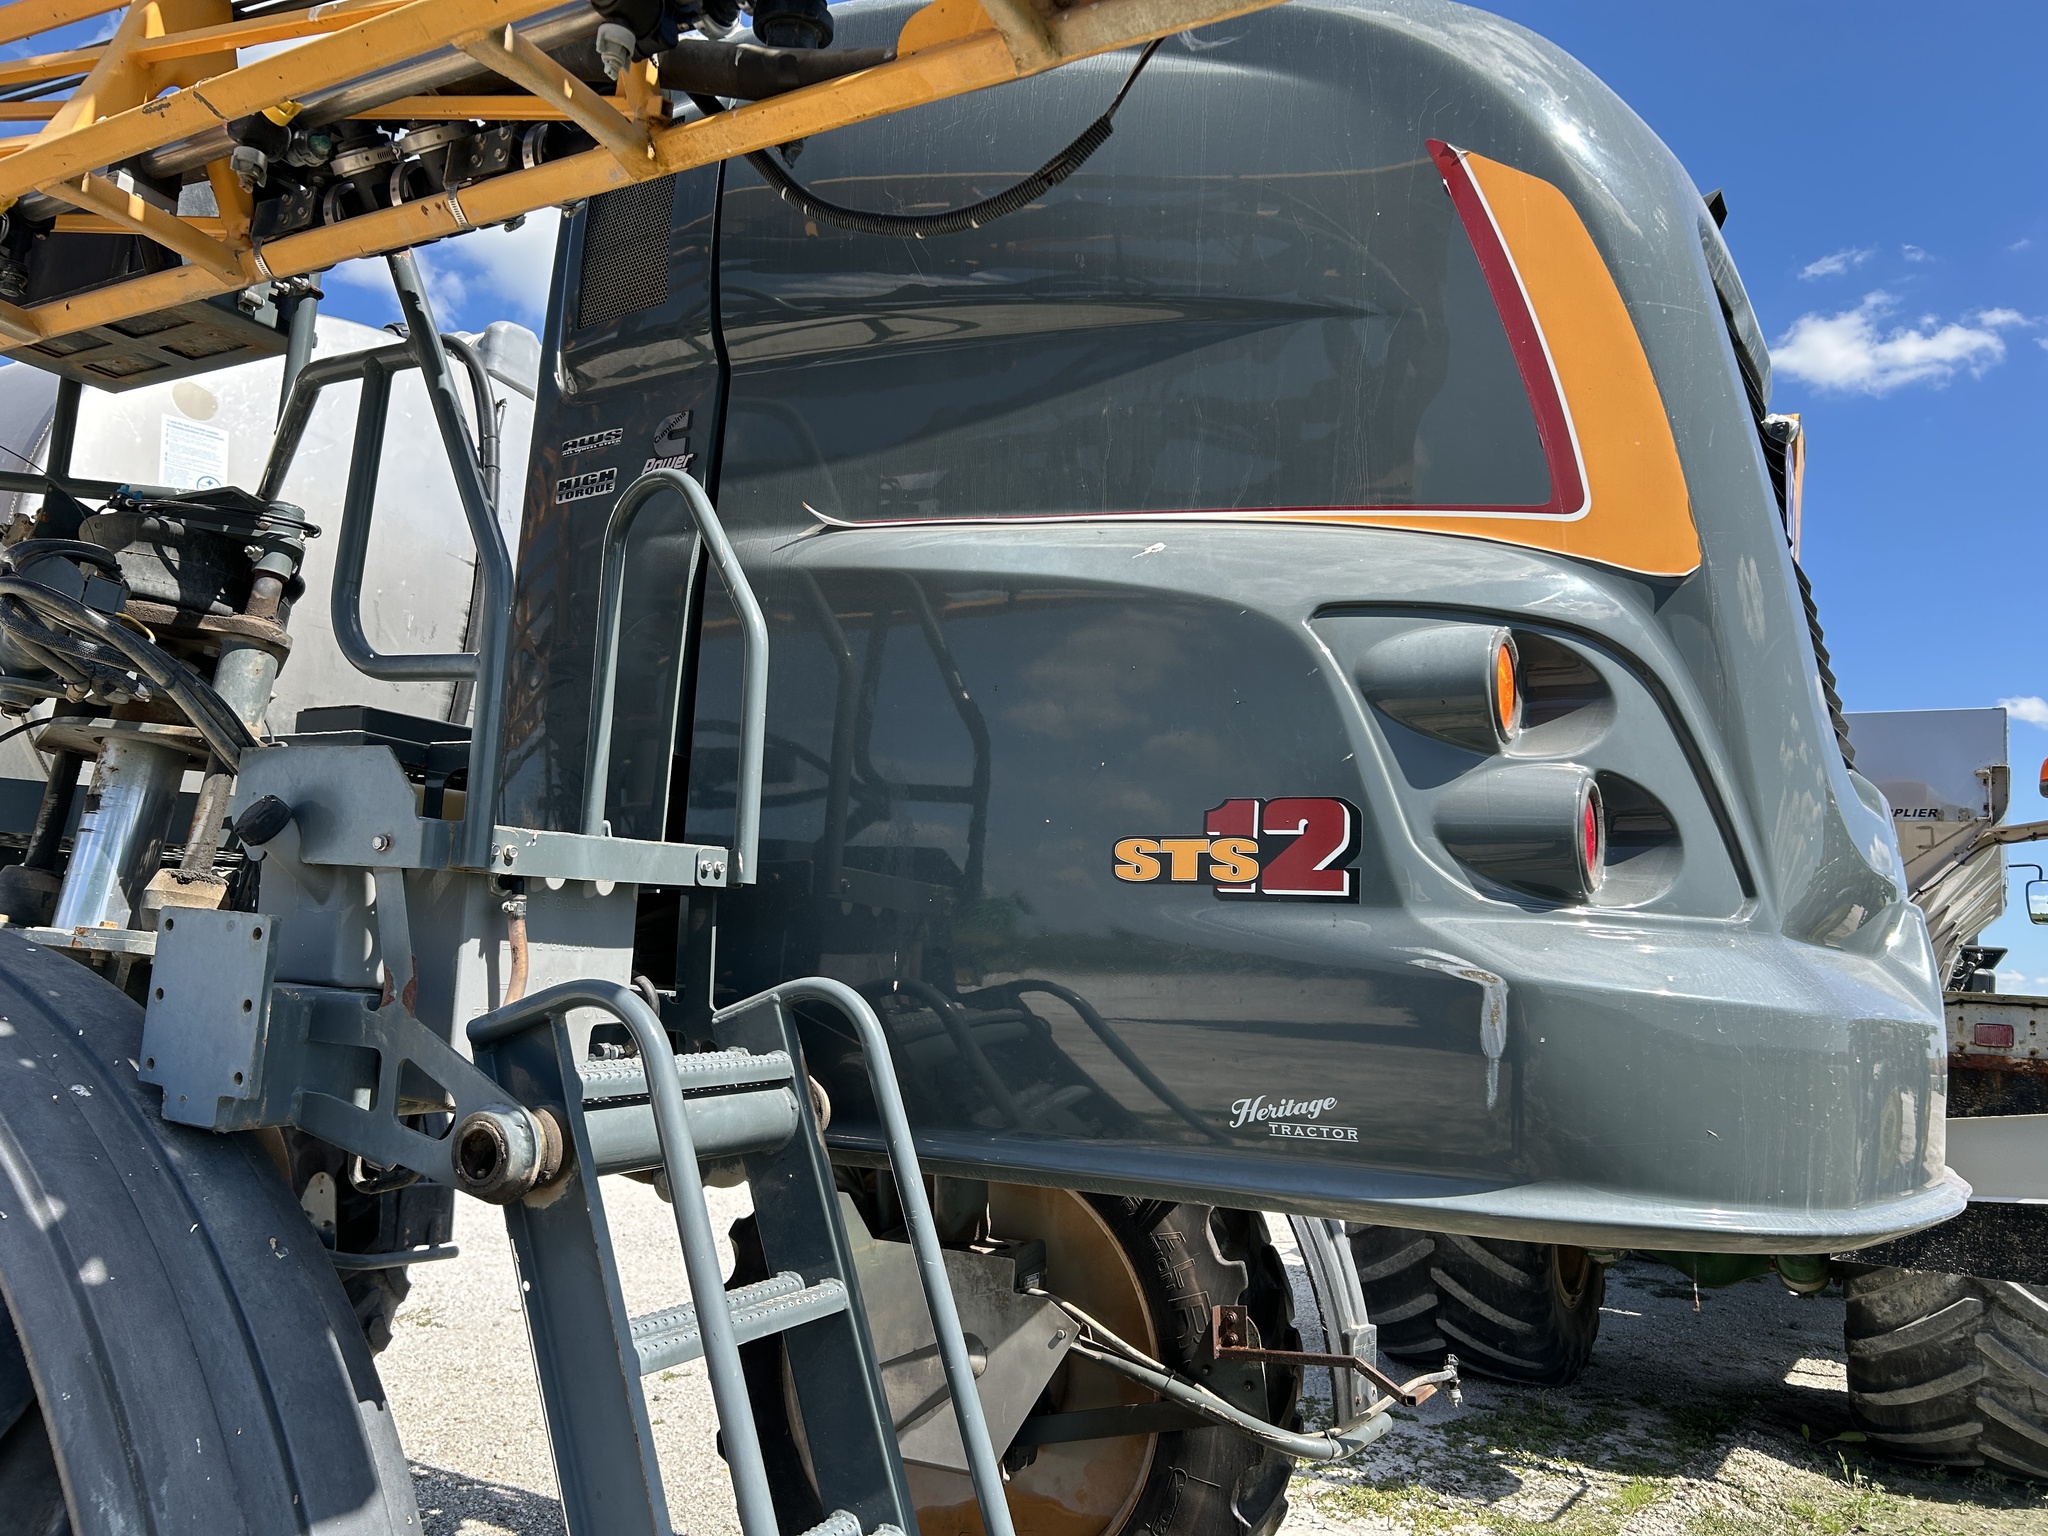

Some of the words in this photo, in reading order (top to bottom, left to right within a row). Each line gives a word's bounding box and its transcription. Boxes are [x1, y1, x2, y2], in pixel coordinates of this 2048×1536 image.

[654, 412, 686, 444] Cummins
[641, 453, 694, 476] Power
[558, 469, 616, 492] HIGH
[558, 483, 615, 502] TORQUE
[1891, 808, 1938, 818] PLIER
[1114, 837, 1259, 884] STS
[555, 897, 599, 912] GALLON
[1229, 1094, 1338, 1128] Heritage
[1269, 1124, 1358, 1140] TRACTOR
